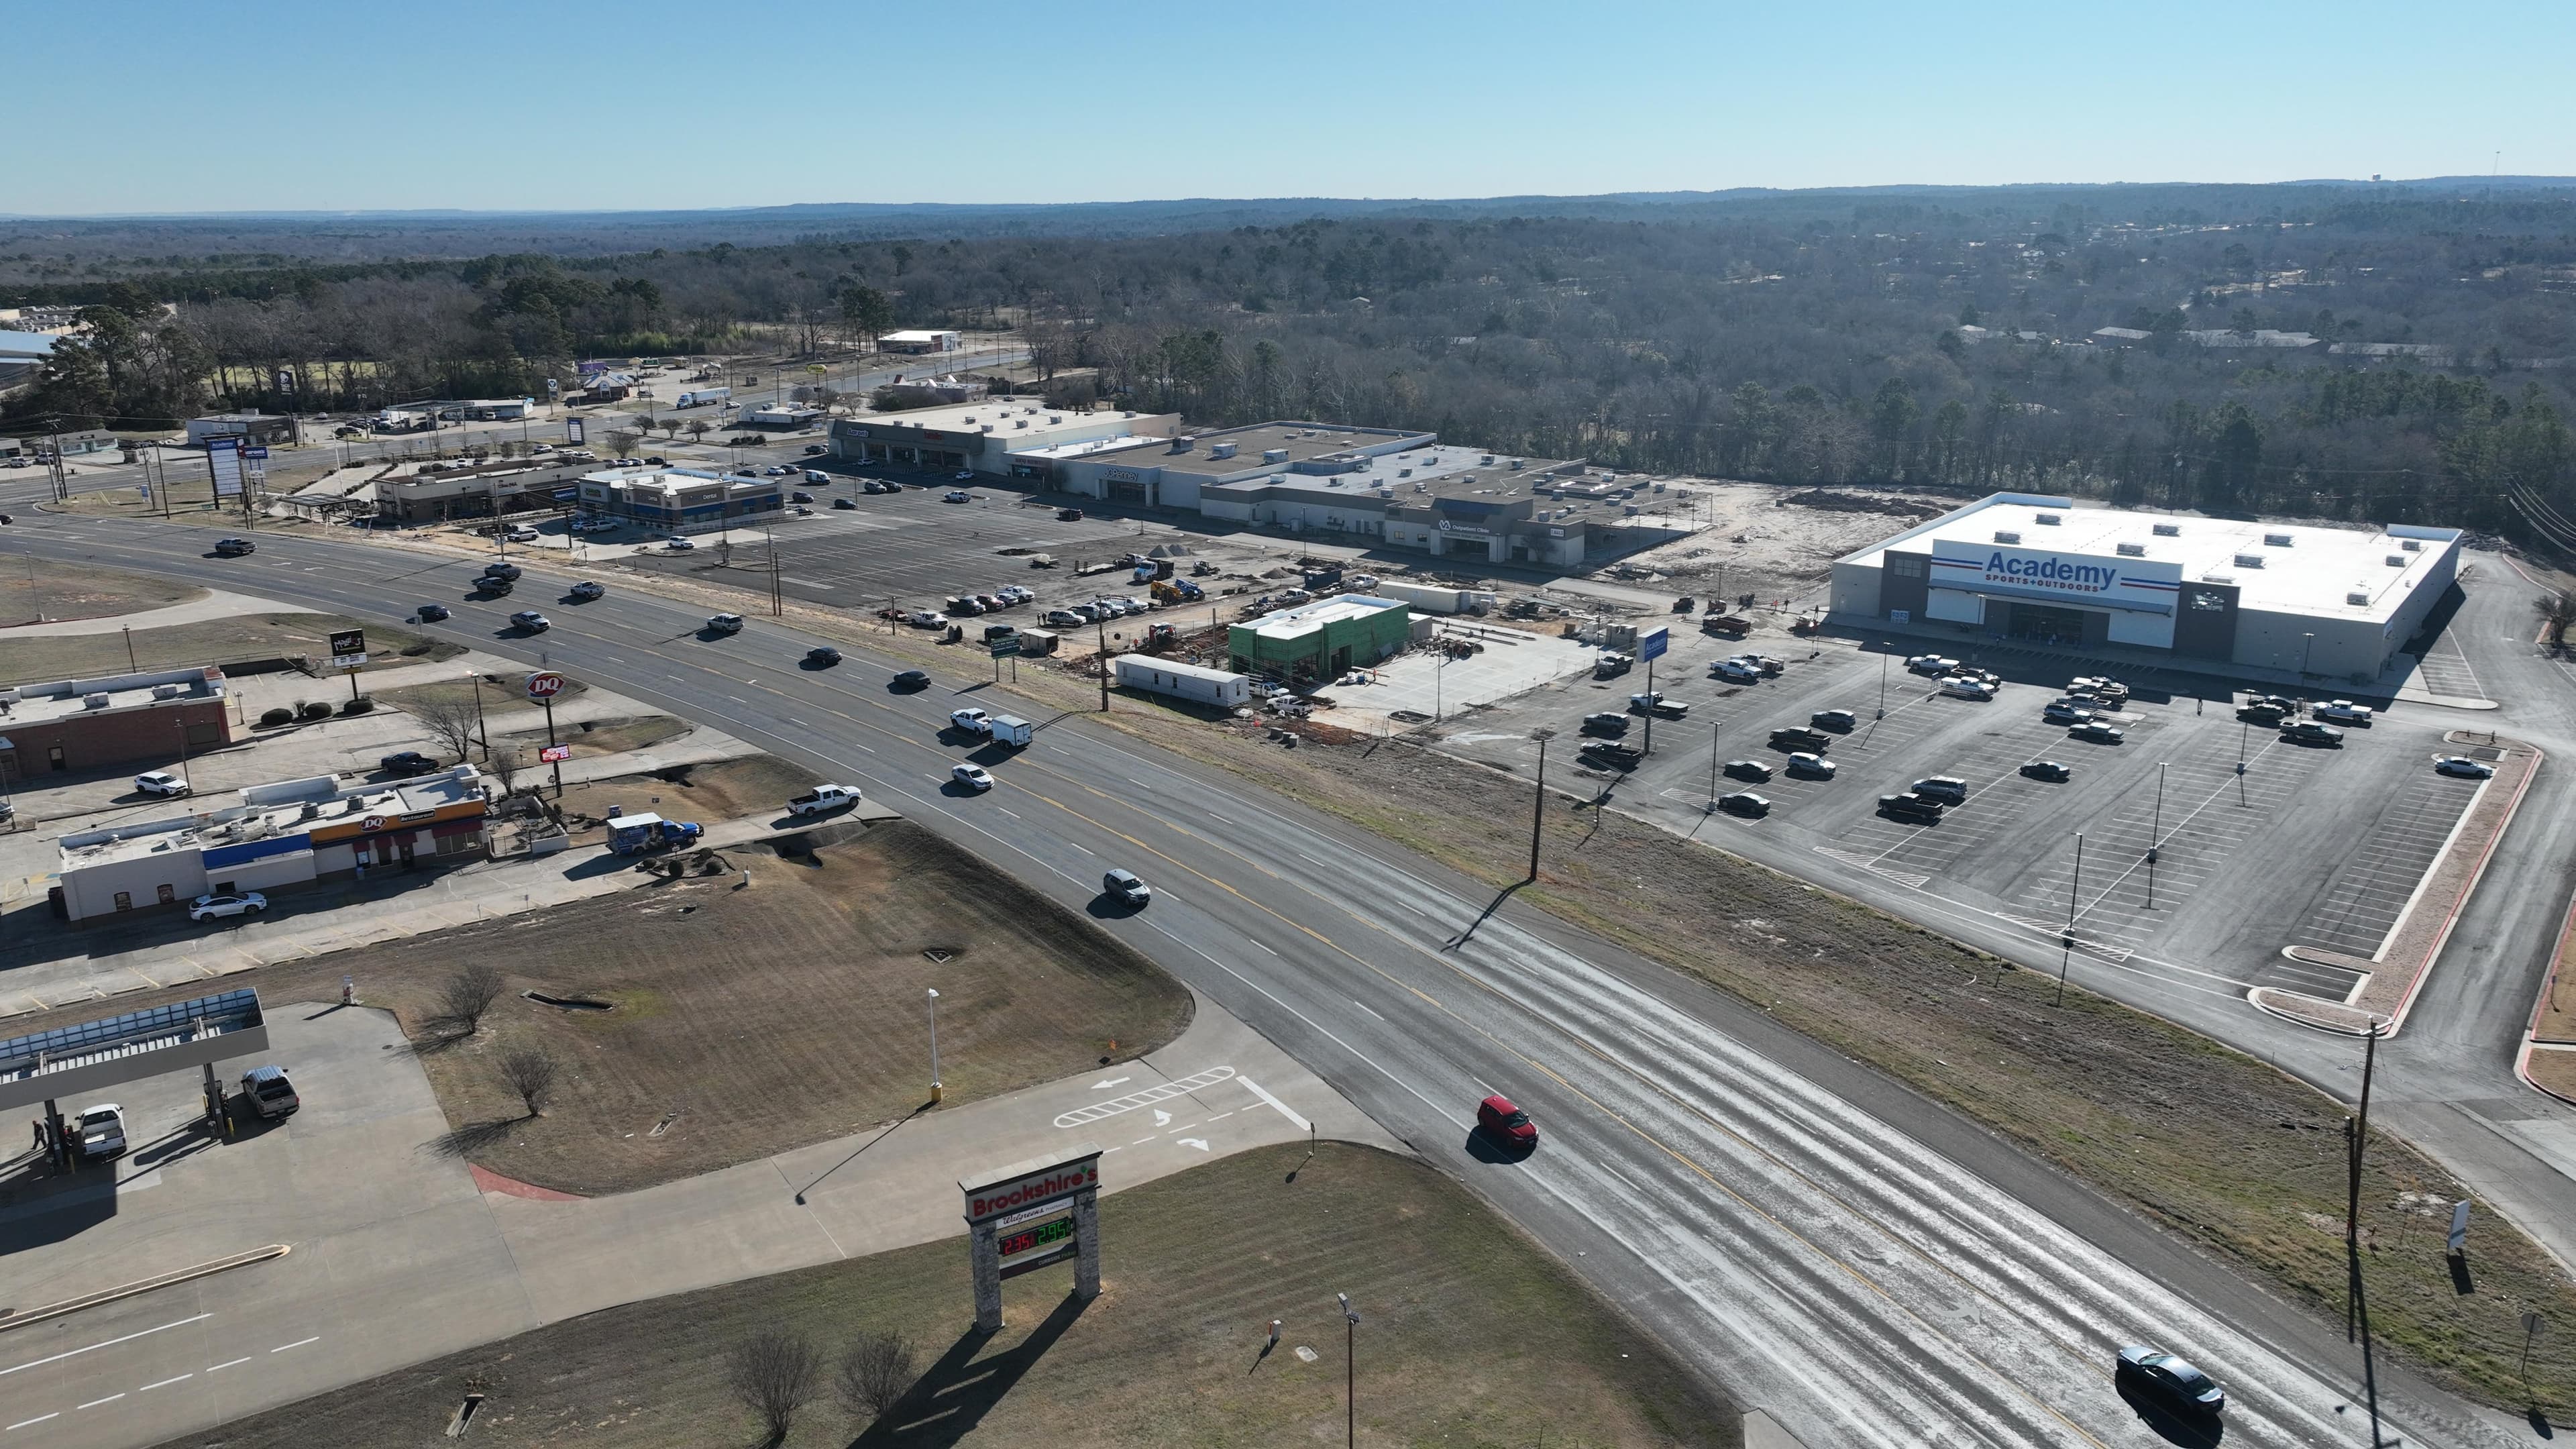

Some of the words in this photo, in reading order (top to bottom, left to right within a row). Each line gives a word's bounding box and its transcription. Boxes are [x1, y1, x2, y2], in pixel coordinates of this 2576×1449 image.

[1104, 468, 1138, 482] JCPenney
[1986, 551, 2116, 591] Academy
[535, 677, 559, 692] DQ
[364, 818, 383, 828] DQ
[400, 812, 435, 822] Restaurant
[973, 1165, 1097, 1217] Brookshire's
[1002, 1207, 1044, 1225] Walgreens
[1038, 1254, 1061, 1266] CURBSIDE
